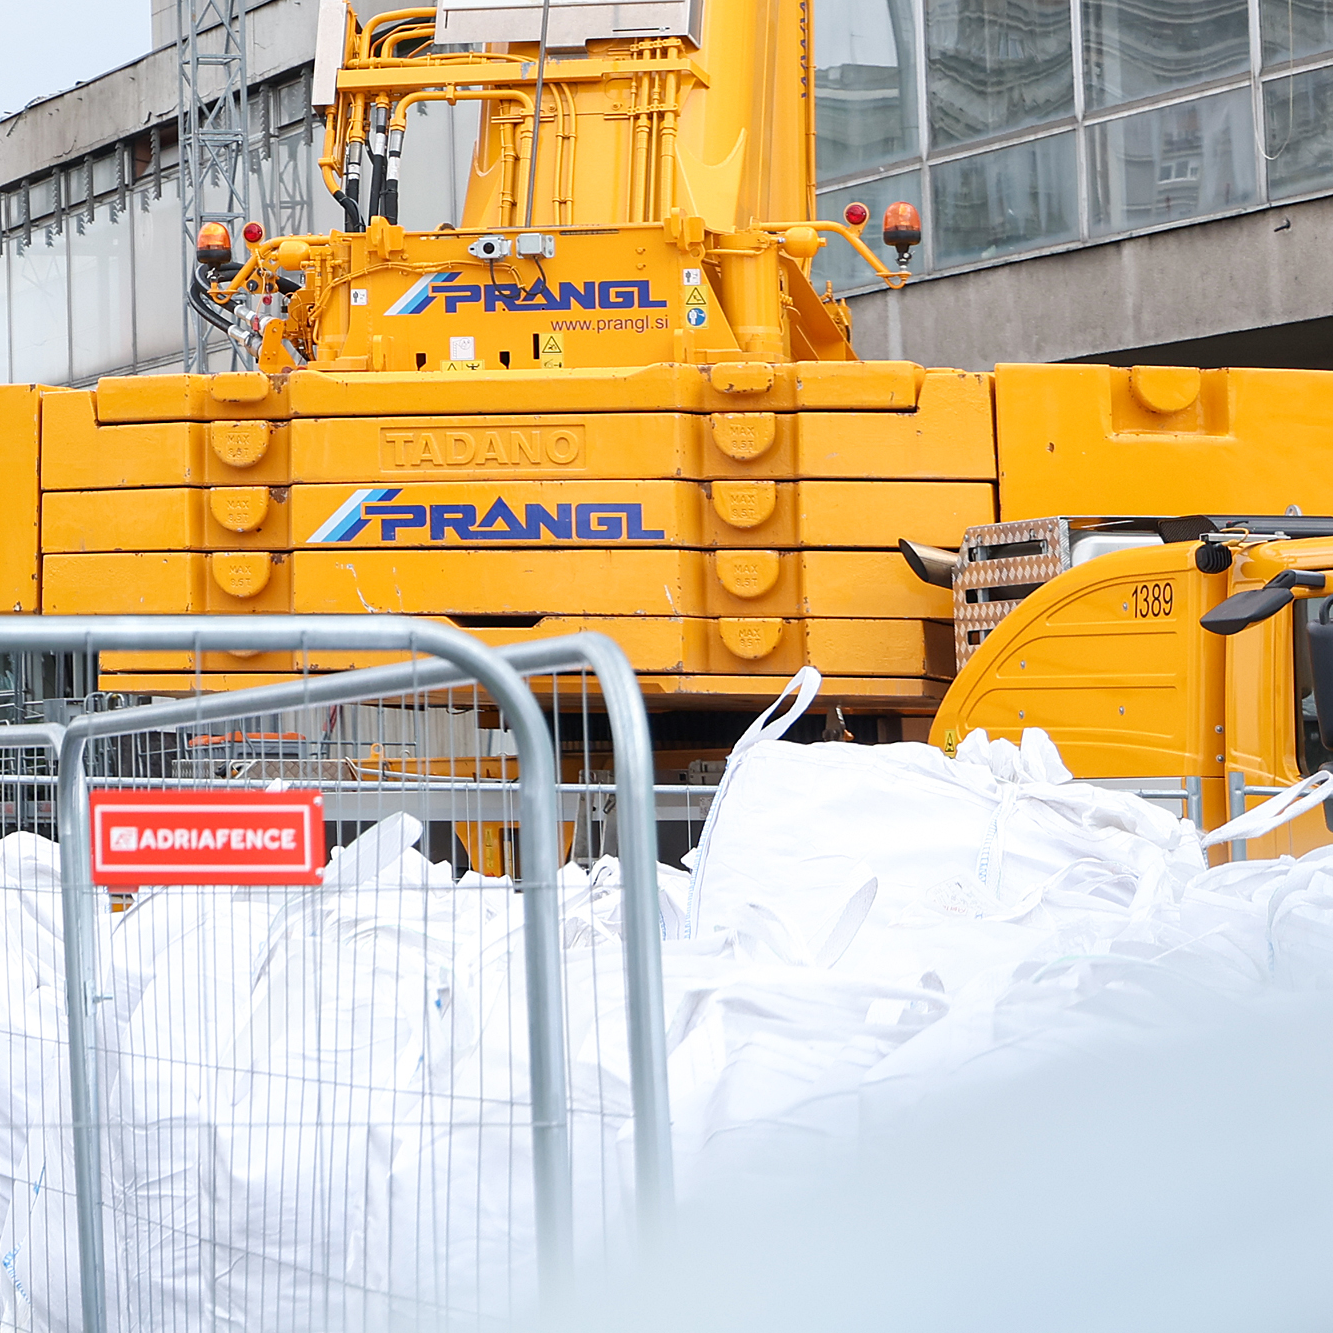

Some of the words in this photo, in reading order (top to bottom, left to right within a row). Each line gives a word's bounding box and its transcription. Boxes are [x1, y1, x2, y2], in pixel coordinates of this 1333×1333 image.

[430, 276, 668, 315] PRANGL
[550, 315, 670, 333] www.prangl.si
[730, 426, 754, 437] MAX
[227, 435, 250, 445] MAX
[385, 429, 580, 467] TADANO
[227, 500, 250, 510] MAX
[731, 494, 755, 505] MAX
[364, 495, 666, 541] PRANGL
[229, 565, 252, 575] MAX
[734, 564, 758, 575] MAX
[1131, 582, 1173, 619] 1389
[738, 628, 760, 638] MAX
[138, 827, 297, 851] ADRIAFENCE
